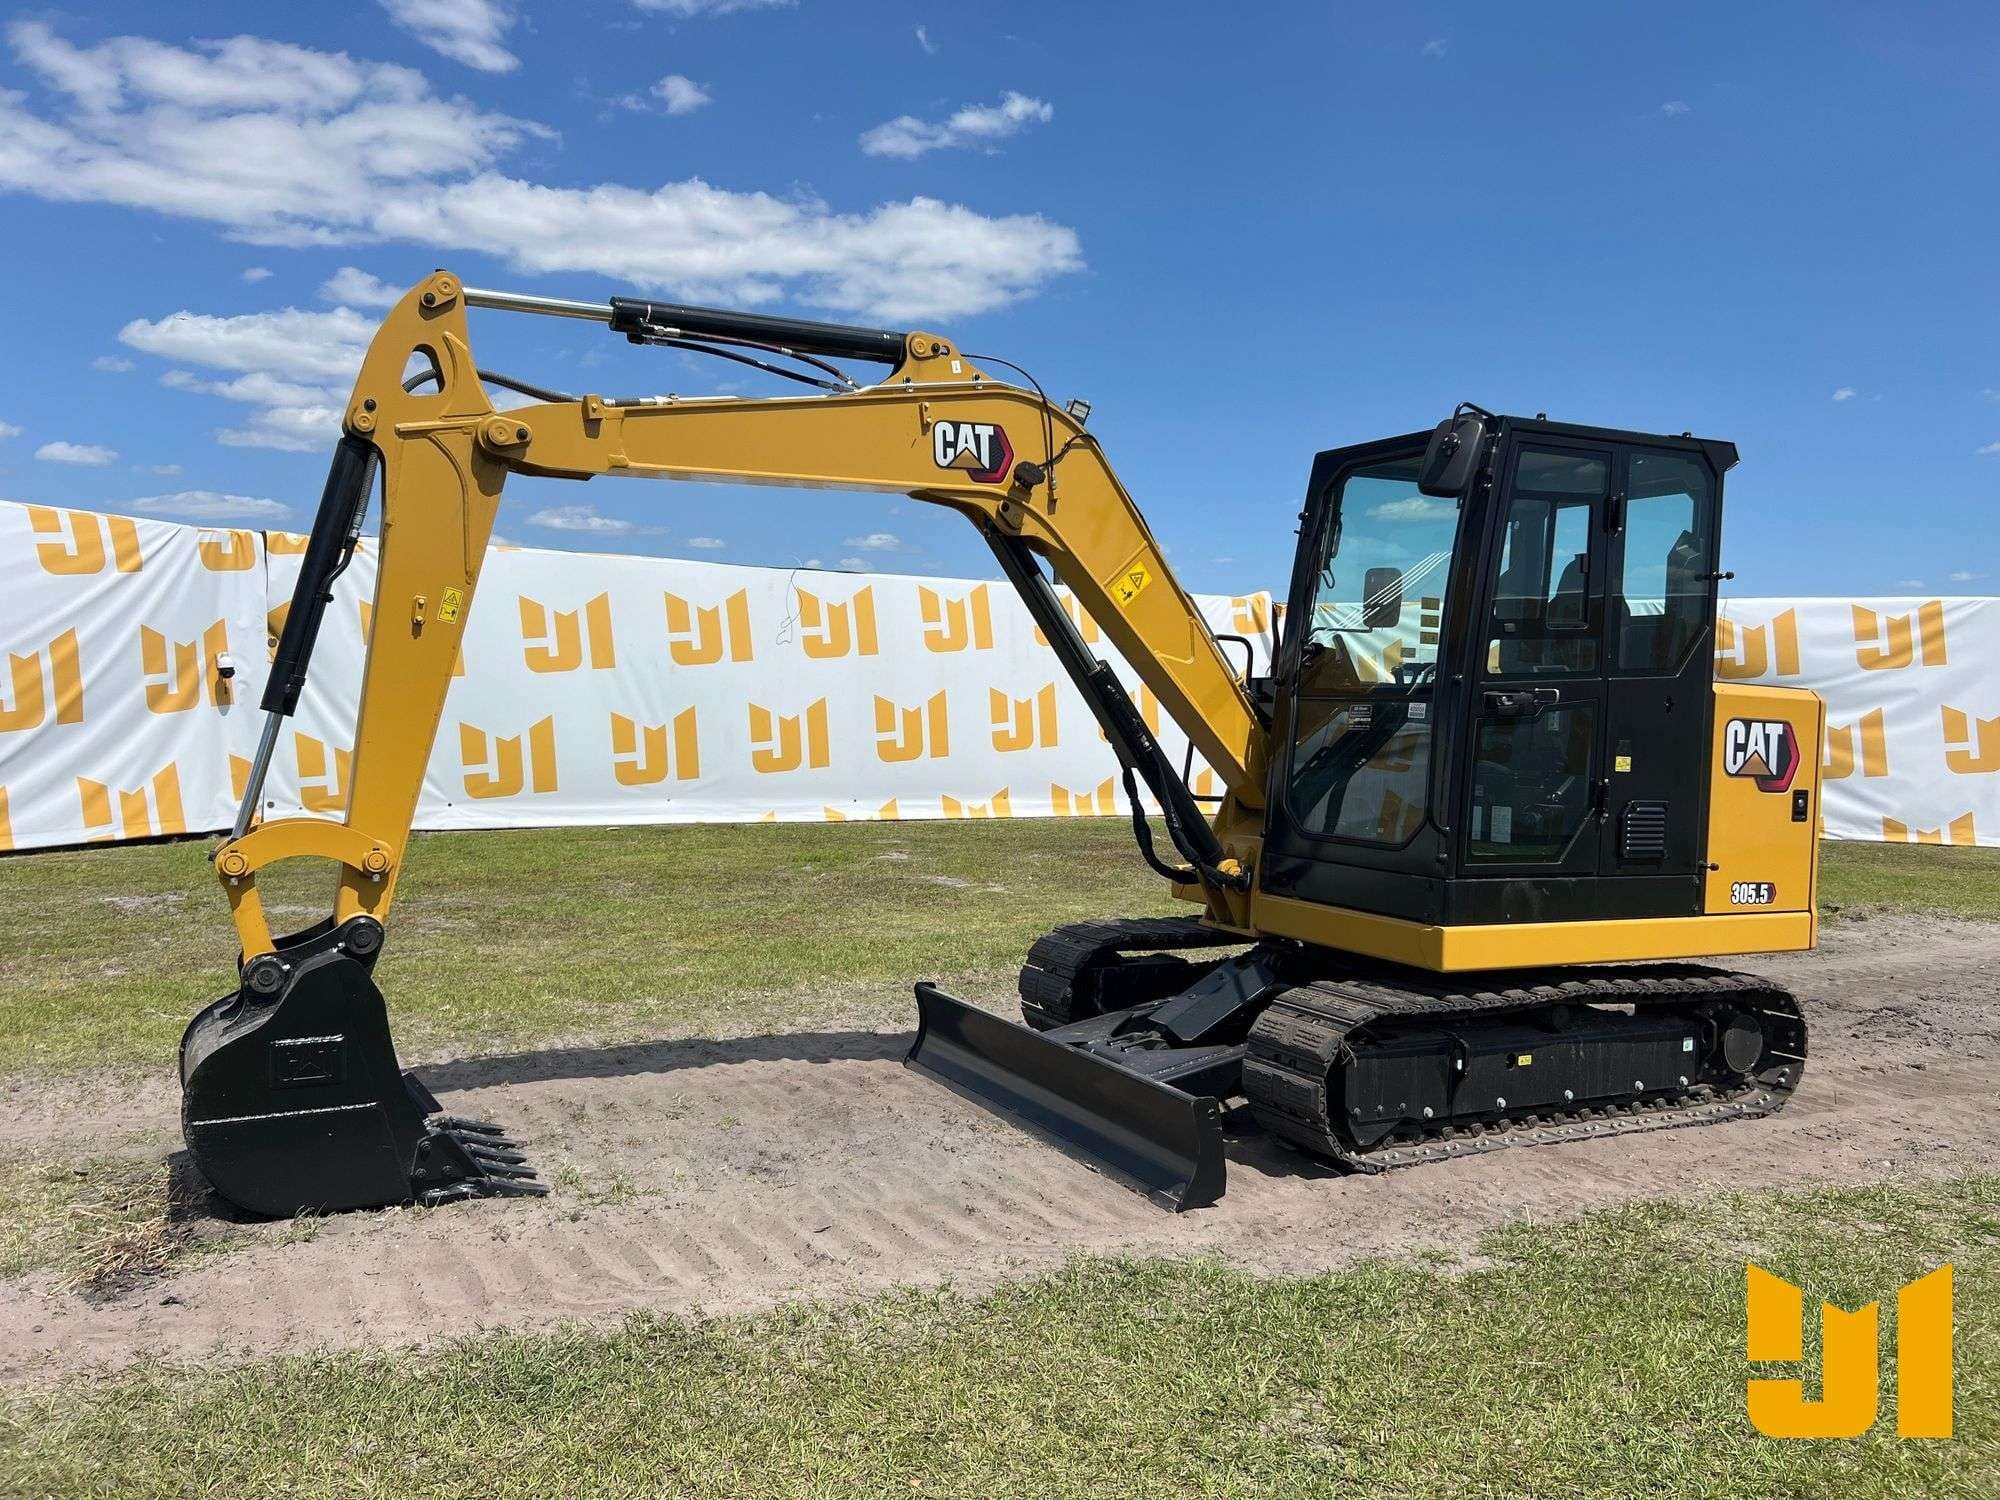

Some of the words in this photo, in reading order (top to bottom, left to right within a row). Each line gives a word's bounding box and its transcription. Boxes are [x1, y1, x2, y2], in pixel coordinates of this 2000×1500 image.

[934, 421, 994, 470] CAT
[1725, 719, 1784, 776] CAT
[1731, 882, 1769, 904] 305.5
